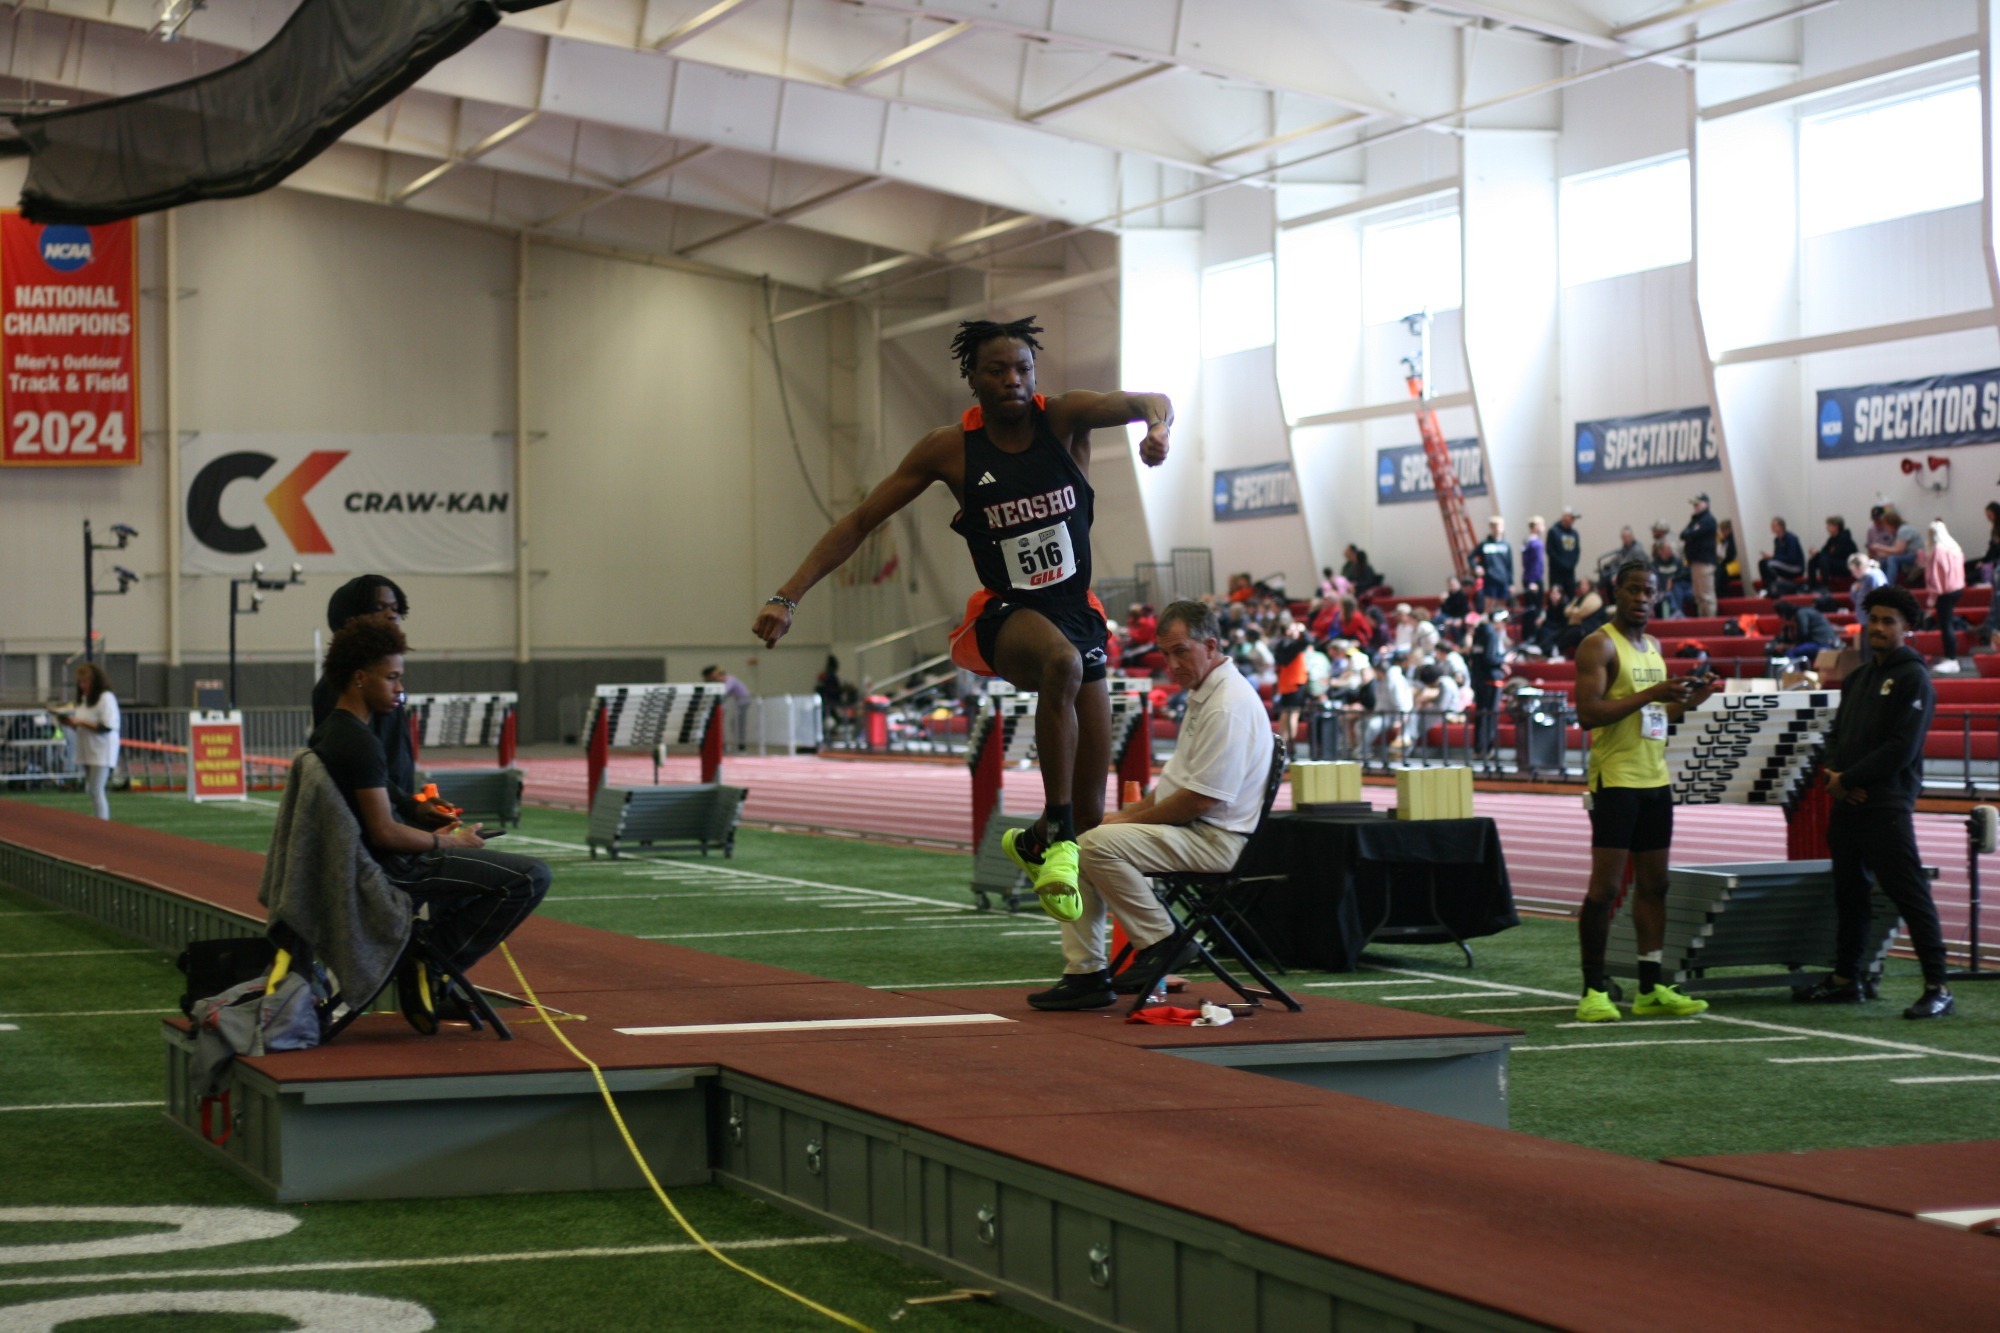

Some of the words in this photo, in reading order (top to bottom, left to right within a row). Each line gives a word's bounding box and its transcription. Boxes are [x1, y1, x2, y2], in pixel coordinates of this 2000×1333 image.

[44, 243, 92, 259] NCAA
[15, 285, 119, 308] NATIONAL
[4, 312, 130, 336] CHAMPIONS
[15, 354, 59, 370] Men's
[62, 354, 121, 370] Outdoor
[9, 373, 60, 392] Track
[65, 373, 79, 392] &
[85, 373, 129, 392] Field
[1853, 384, 1978, 443] SPECTATOR
[1981, 381, 2000, 429] S
[13, 410, 128, 454] 2024
[1603, 419, 1702, 470] SPECTATOR
[344, 491, 509, 513] CRAW-KAN
[983, 485, 1077, 529] NEOSHO
[1017, 541, 1063, 575] 516
[1030, 566, 1064, 586] GILL
[1723, 695, 1779, 709] UCS
[1713, 710, 1769, 722] UCS
[1705, 723, 1760, 734] UCS
[1697, 735, 1752, 745] UCS
[1693, 746, 1748, 758] UCS
[1685, 759, 1740, 770] UCS
[1678, 771, 1733, 782] UCS
[1672, 782, 1727, 793] UCS
